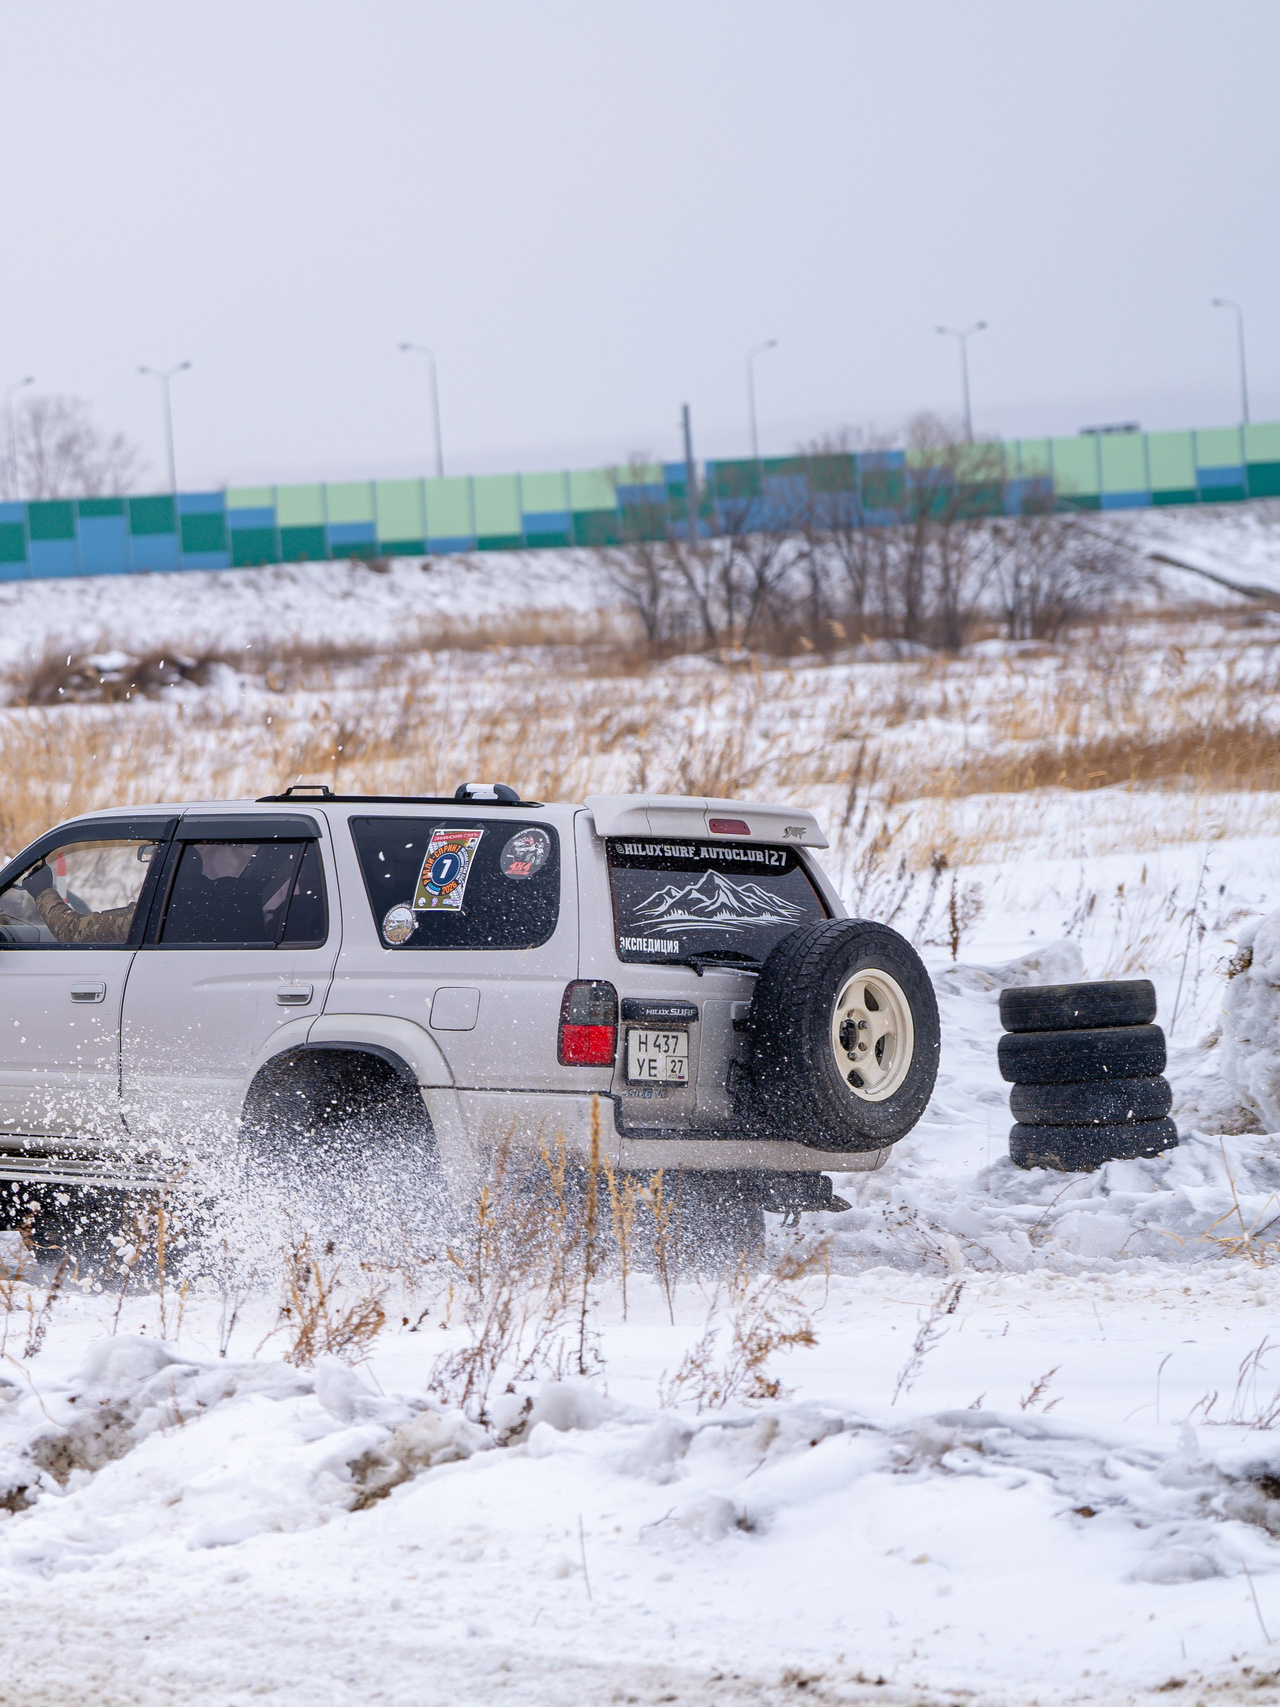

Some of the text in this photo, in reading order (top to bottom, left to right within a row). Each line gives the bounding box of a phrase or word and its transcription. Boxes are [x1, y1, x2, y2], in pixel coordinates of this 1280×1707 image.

[439, 859, 453, 879] 7
[619, 936, 680, 955] ЭКСПЕДИЦИЯ
[653, 1034, 679, 1054] 437
[670, 1059, 684, 1074] 27
